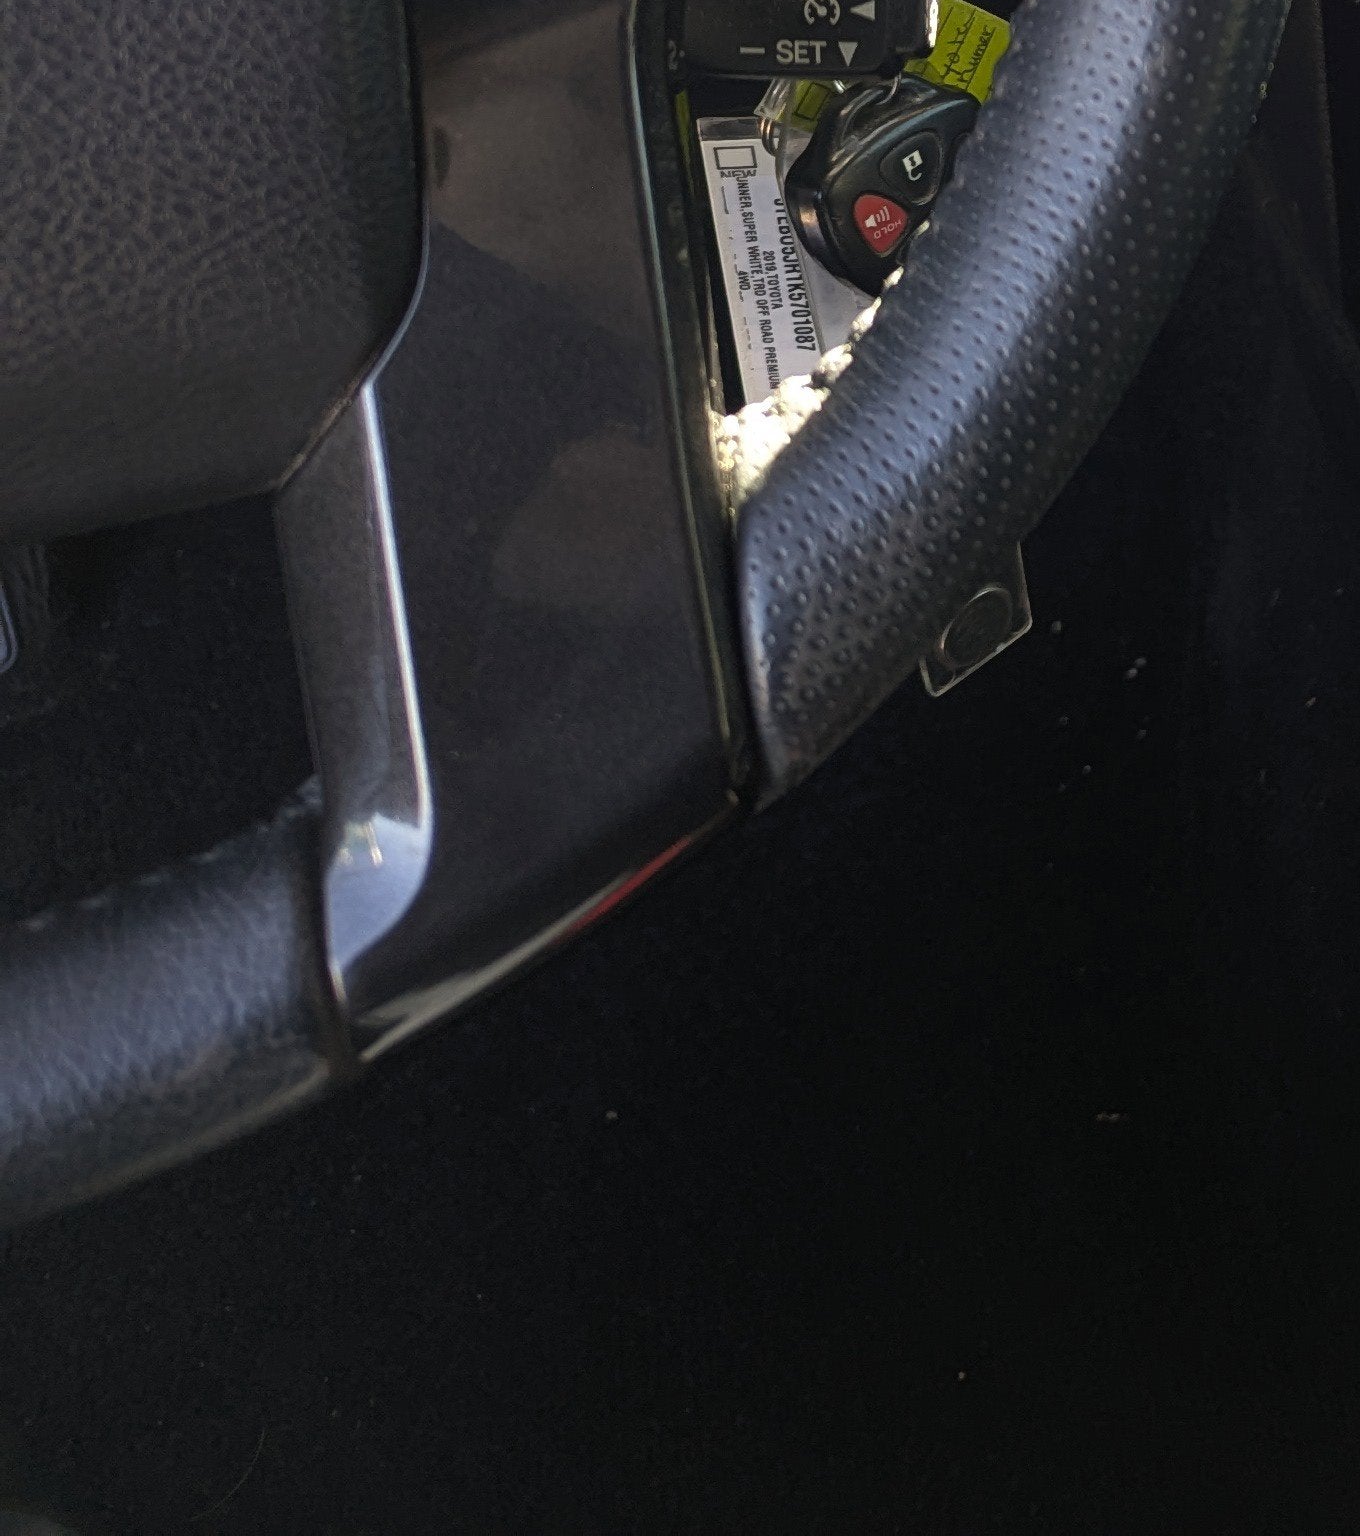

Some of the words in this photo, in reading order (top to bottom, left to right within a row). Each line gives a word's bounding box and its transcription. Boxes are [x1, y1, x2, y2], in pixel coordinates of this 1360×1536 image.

[776, 39, 827, 64] SET
[874, 220, 902, 240] HOLD
[737, 270, 751, 291] 4WD
[755, 298, 771, 316] OFF
[759, 318, 775, 344] ROAD
